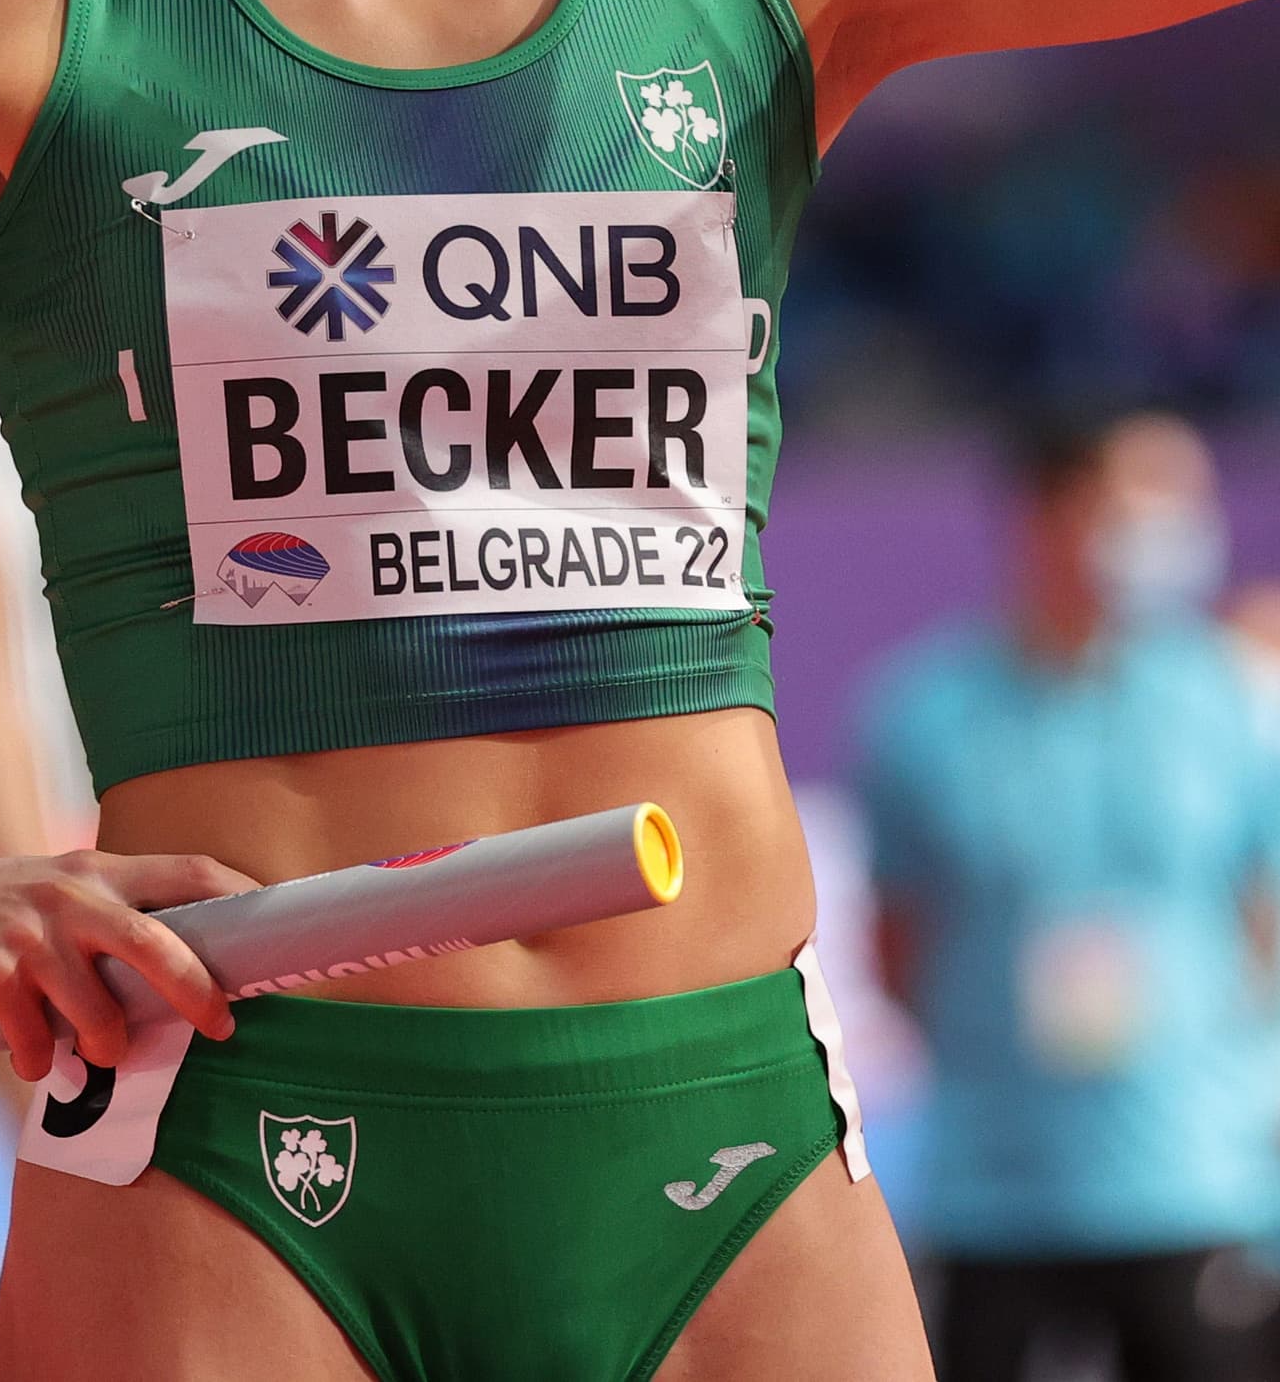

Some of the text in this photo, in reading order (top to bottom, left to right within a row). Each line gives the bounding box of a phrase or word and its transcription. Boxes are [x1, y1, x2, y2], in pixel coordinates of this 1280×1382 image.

[422, 224, 681, 322] QNB
[222, 367, 708, 501] BECKER
[370, 525, 729, 597] BELGRADE 22
